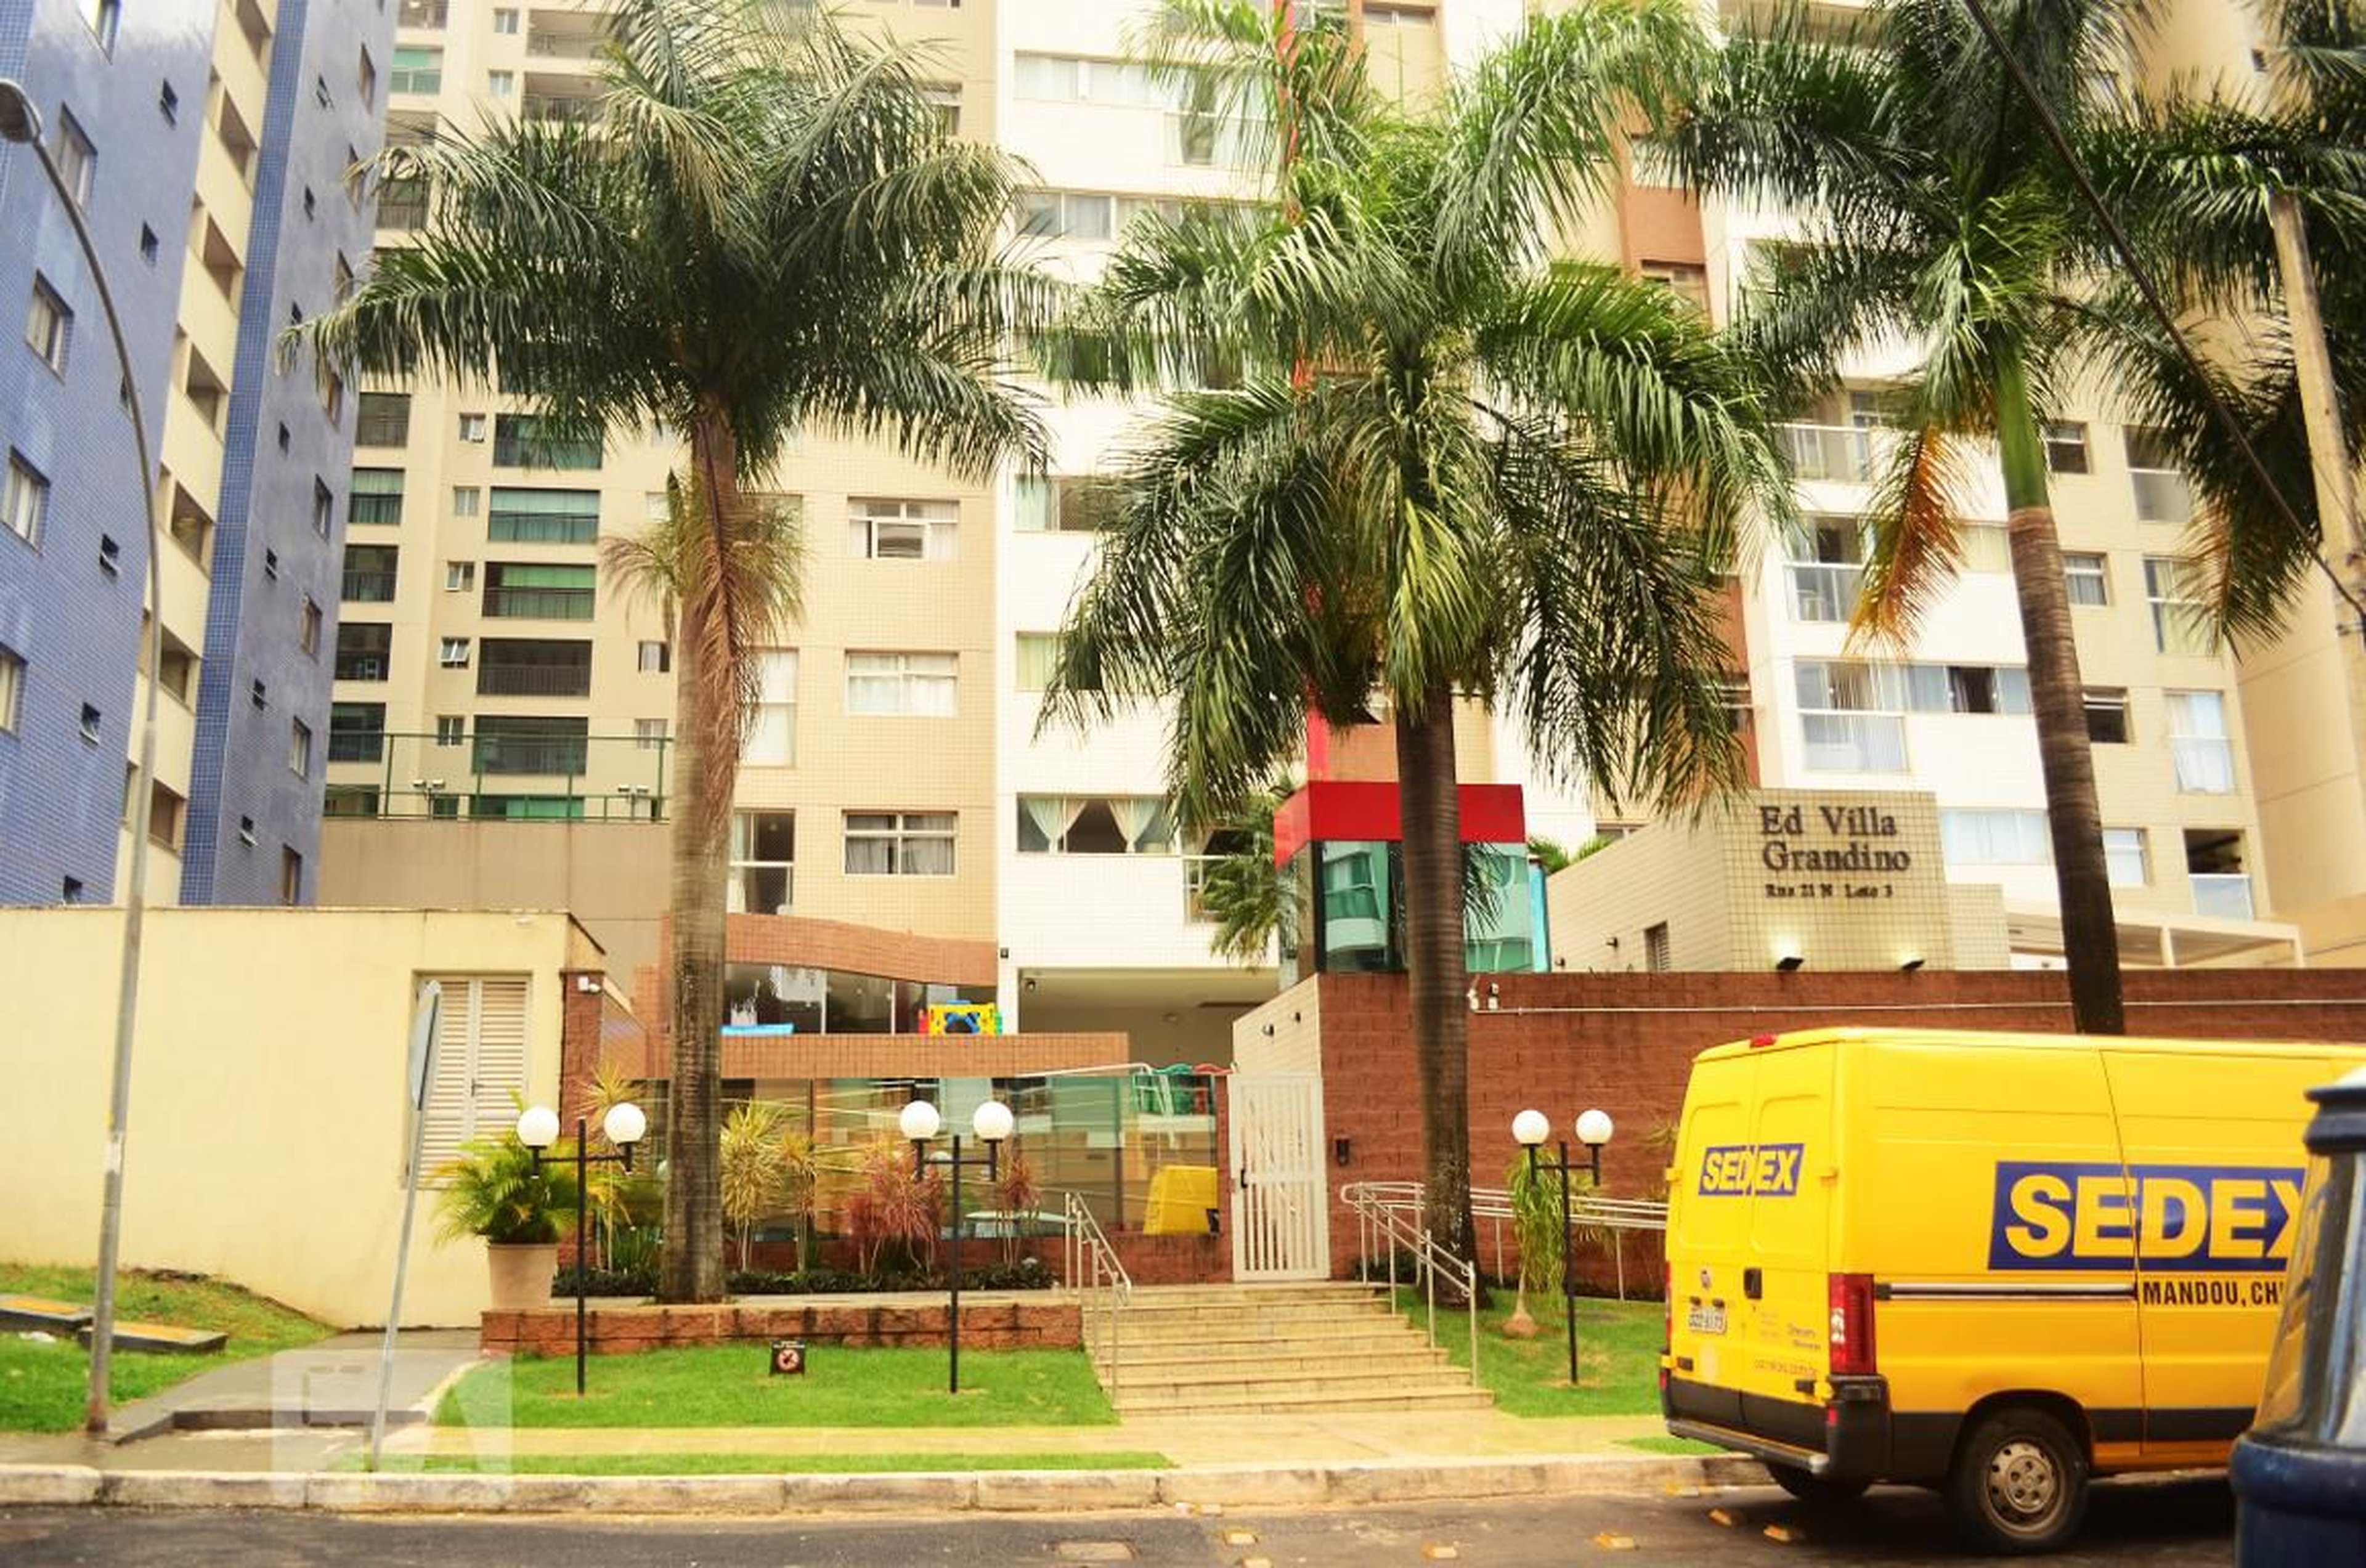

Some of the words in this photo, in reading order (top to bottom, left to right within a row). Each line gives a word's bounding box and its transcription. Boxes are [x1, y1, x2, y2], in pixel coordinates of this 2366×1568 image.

[1760, 805, 1803, 835] Ed
[1819, 806, 1897, 836] Villa
[1762, 841, 1911, 871] Grandino
[1702, 1149, 1799, 1193] SEDEX
[2142, 1281, 2246, 1307] MANDOU,
[2251, 1282, 2283, 1305] CH
